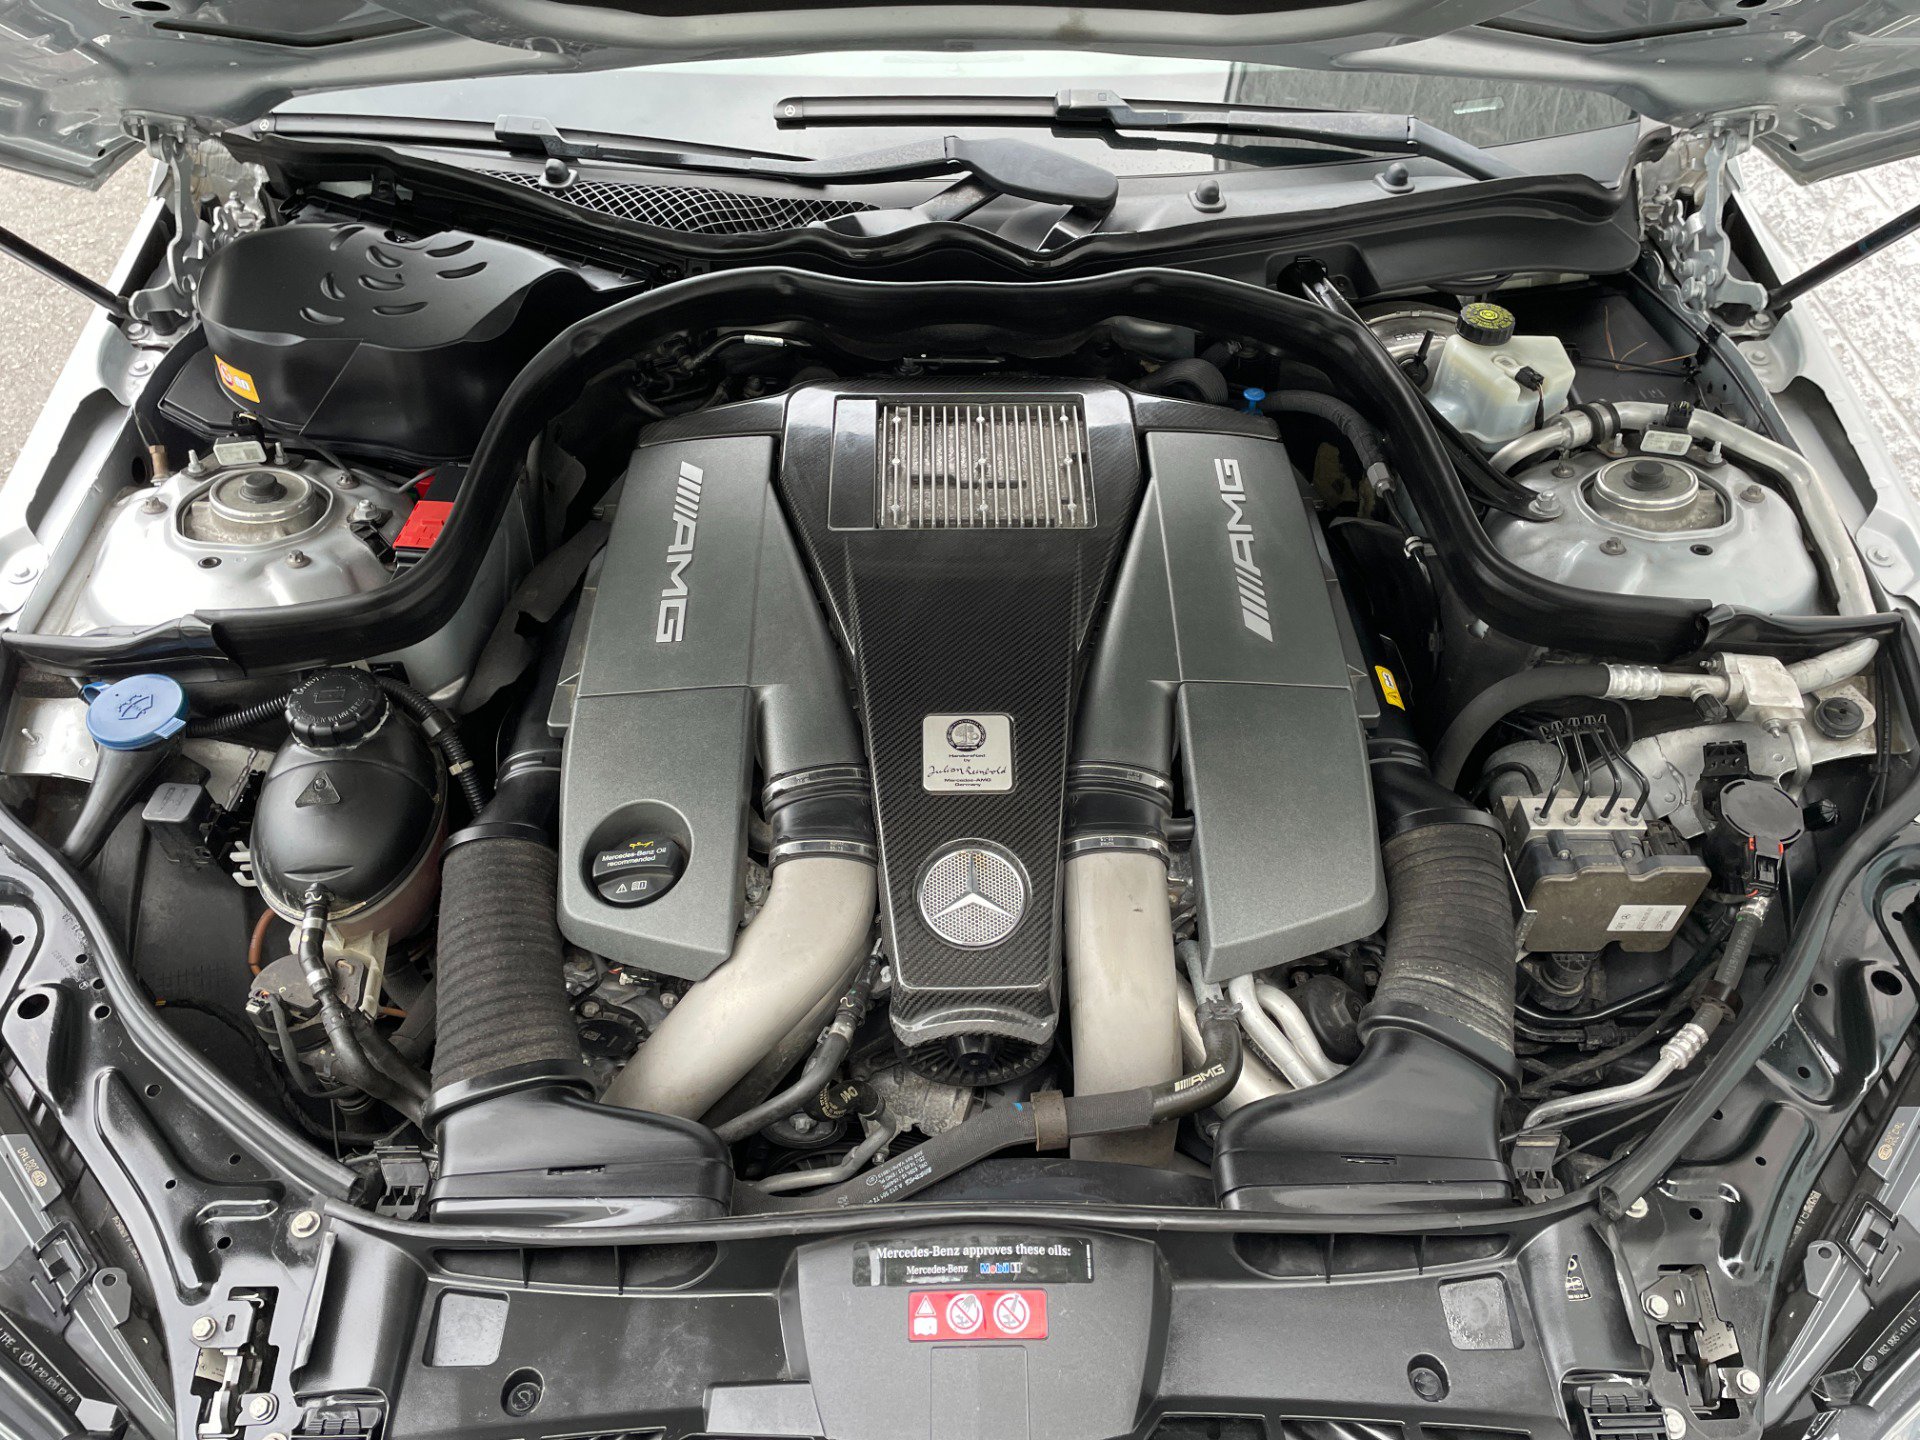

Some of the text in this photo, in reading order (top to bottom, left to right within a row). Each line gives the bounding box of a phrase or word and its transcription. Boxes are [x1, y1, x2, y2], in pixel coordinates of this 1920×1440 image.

[1214, 458, 1262, 588] AMG
[656, 512, 697, 643] AMG
[601, 849, 655, 862] Mercedes-Benz
[606, 855, 656, 867] recommended
[1187, 1064, 1226, 1089] AMG
[876, 1243, 1072, 1259] Mercedes-Benz approves these oils:
[906, 1264, 969, 1275] Mercedes-Benz
[979, 1263, 1010, 1274] Mobil
